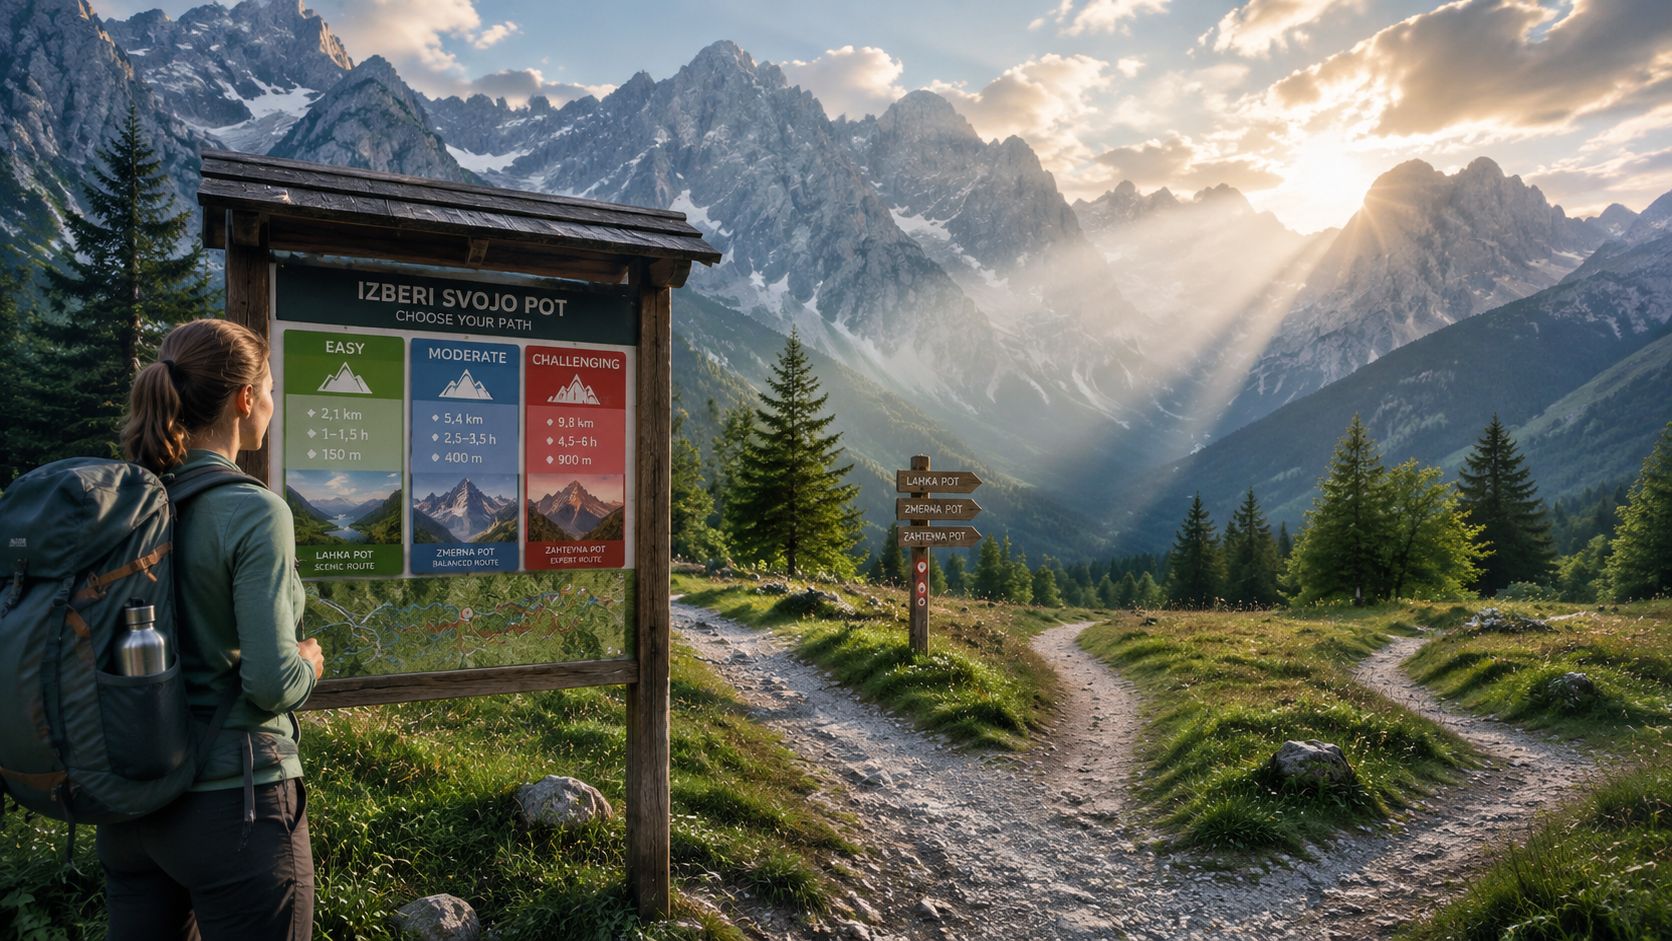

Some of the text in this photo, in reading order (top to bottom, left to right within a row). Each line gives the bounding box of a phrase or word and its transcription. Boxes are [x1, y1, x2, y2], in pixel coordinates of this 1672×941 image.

[358, 281, 567, 317] IZBERI SVOJO POT
[395, 310, 532, 331] CHOOSE YOUR PATH
[326, 340, 365, 354] EASY
[428, 347, 507, 364] MODERATE
[532, 353, 620, 370] CHALLENGING
[321, 407, 362, 421] 2,1 km
[466, 413, 483, 424] km
[578, 417, 594, 428] km
[361, 429, 369, 441] h
[489, 433, 496, 445] h
[590, 437, 597, 447] h
[322, 448, 361, 461] 150 m
[444, 452, 482, 463] 400 m
[558, 454, 592, 465] 900 m
[906, 476, 959, 486] LAHKA POT
[945, 504, 963, 514] POT
[949, 531, 966, 541] POT
[436, 547, 495, 557] ZMERNA POT
[590, 545, 606, 553] POT
[315, 550, 374, 560] LAHKA POT
[346, 562, 375, 570] ROUTE
